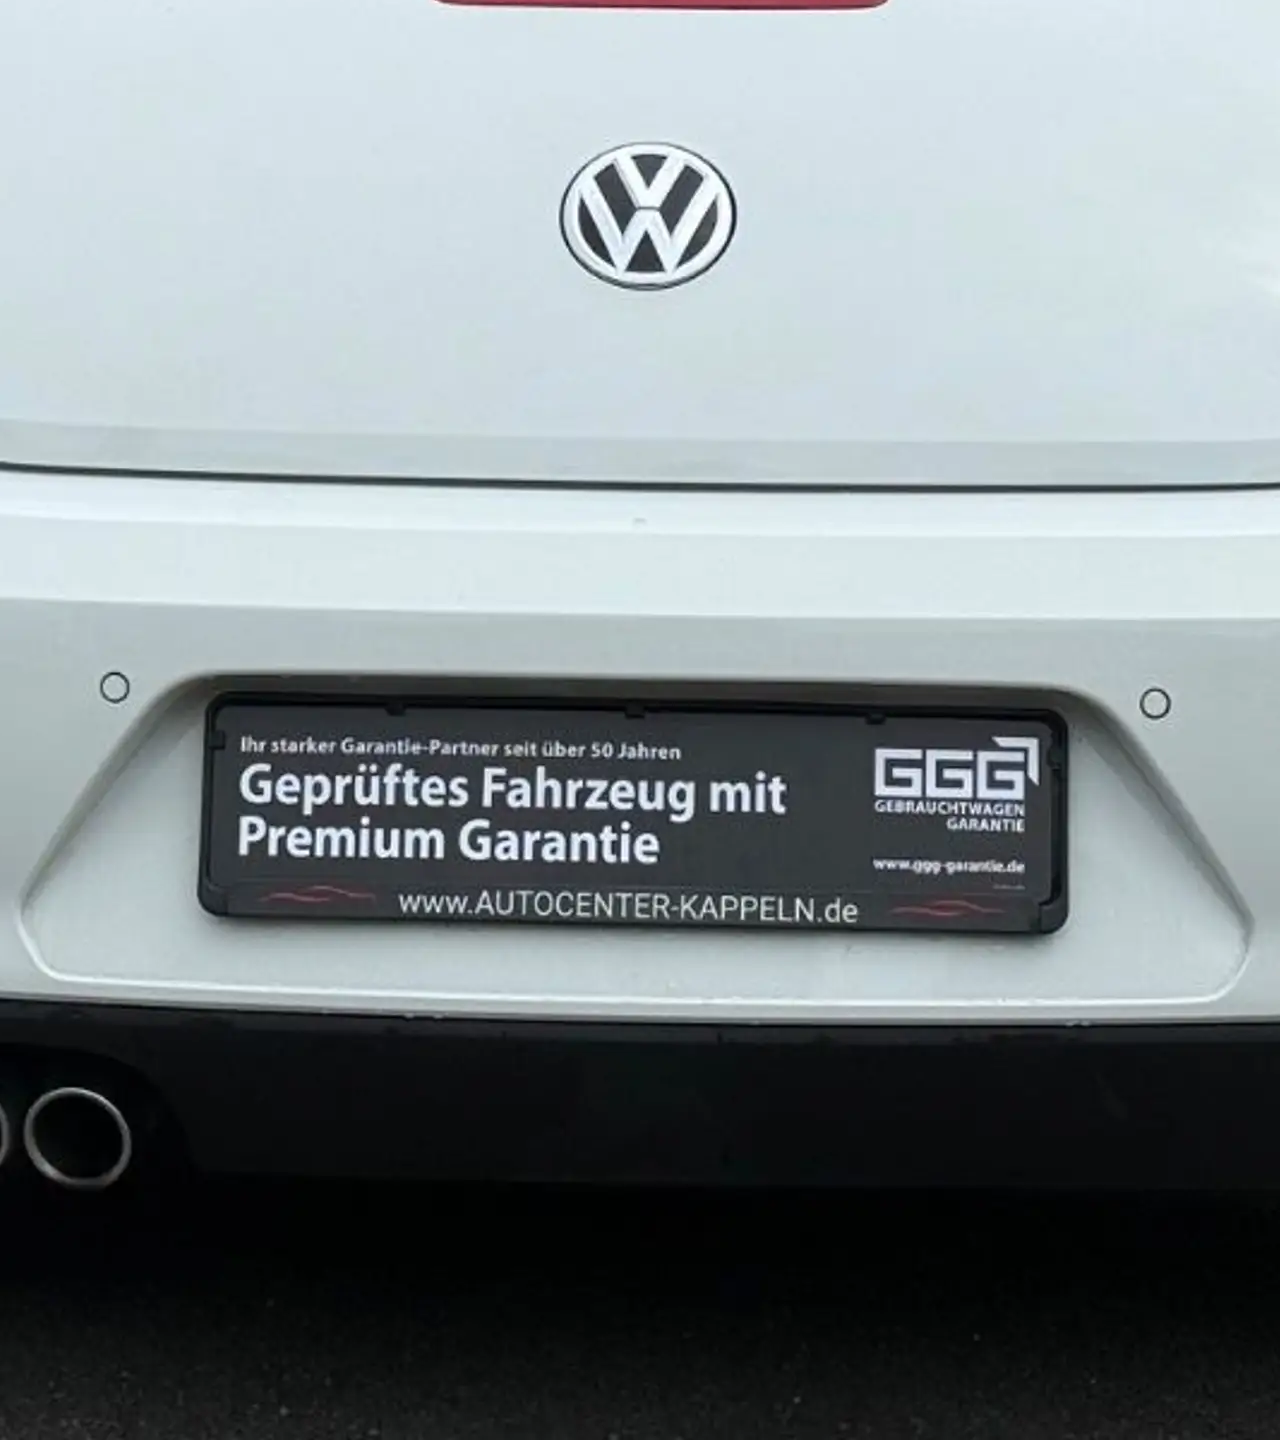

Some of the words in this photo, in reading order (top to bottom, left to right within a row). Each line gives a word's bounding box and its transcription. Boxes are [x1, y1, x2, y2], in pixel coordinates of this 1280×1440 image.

[577, 152, 720, 273] VW
[240, 736, 267, 754] Ihr
[270, 735, 337, 755] starker
[340, 737, 499, 758] Garantie-Partner
[503, 741, 537, 758] seit
[541, 740, 586, 759] über
[591, 742, 614, 759] 50
[617, 741, 682, 761] Jahren
[874, 747, 1026, 801] GGG
[239, 763, 470, 816] Geprüftes
[481, 766, 696, 823] Fahrzeug
[709, 770, 788, 815] mit
[874, 799, 1026, 818] GEBRAUCHTWAGEN
[238, 815, 446, 861] Premium
[458, 818, 661, 865] Garantie
[946, 815, 1026, 833] GARANTIE
[873, 858, 1026, 876] www.ggg-garantie.de
[399, 890, 859, 924] www.AUTOCENTER-KAPPELN.de
